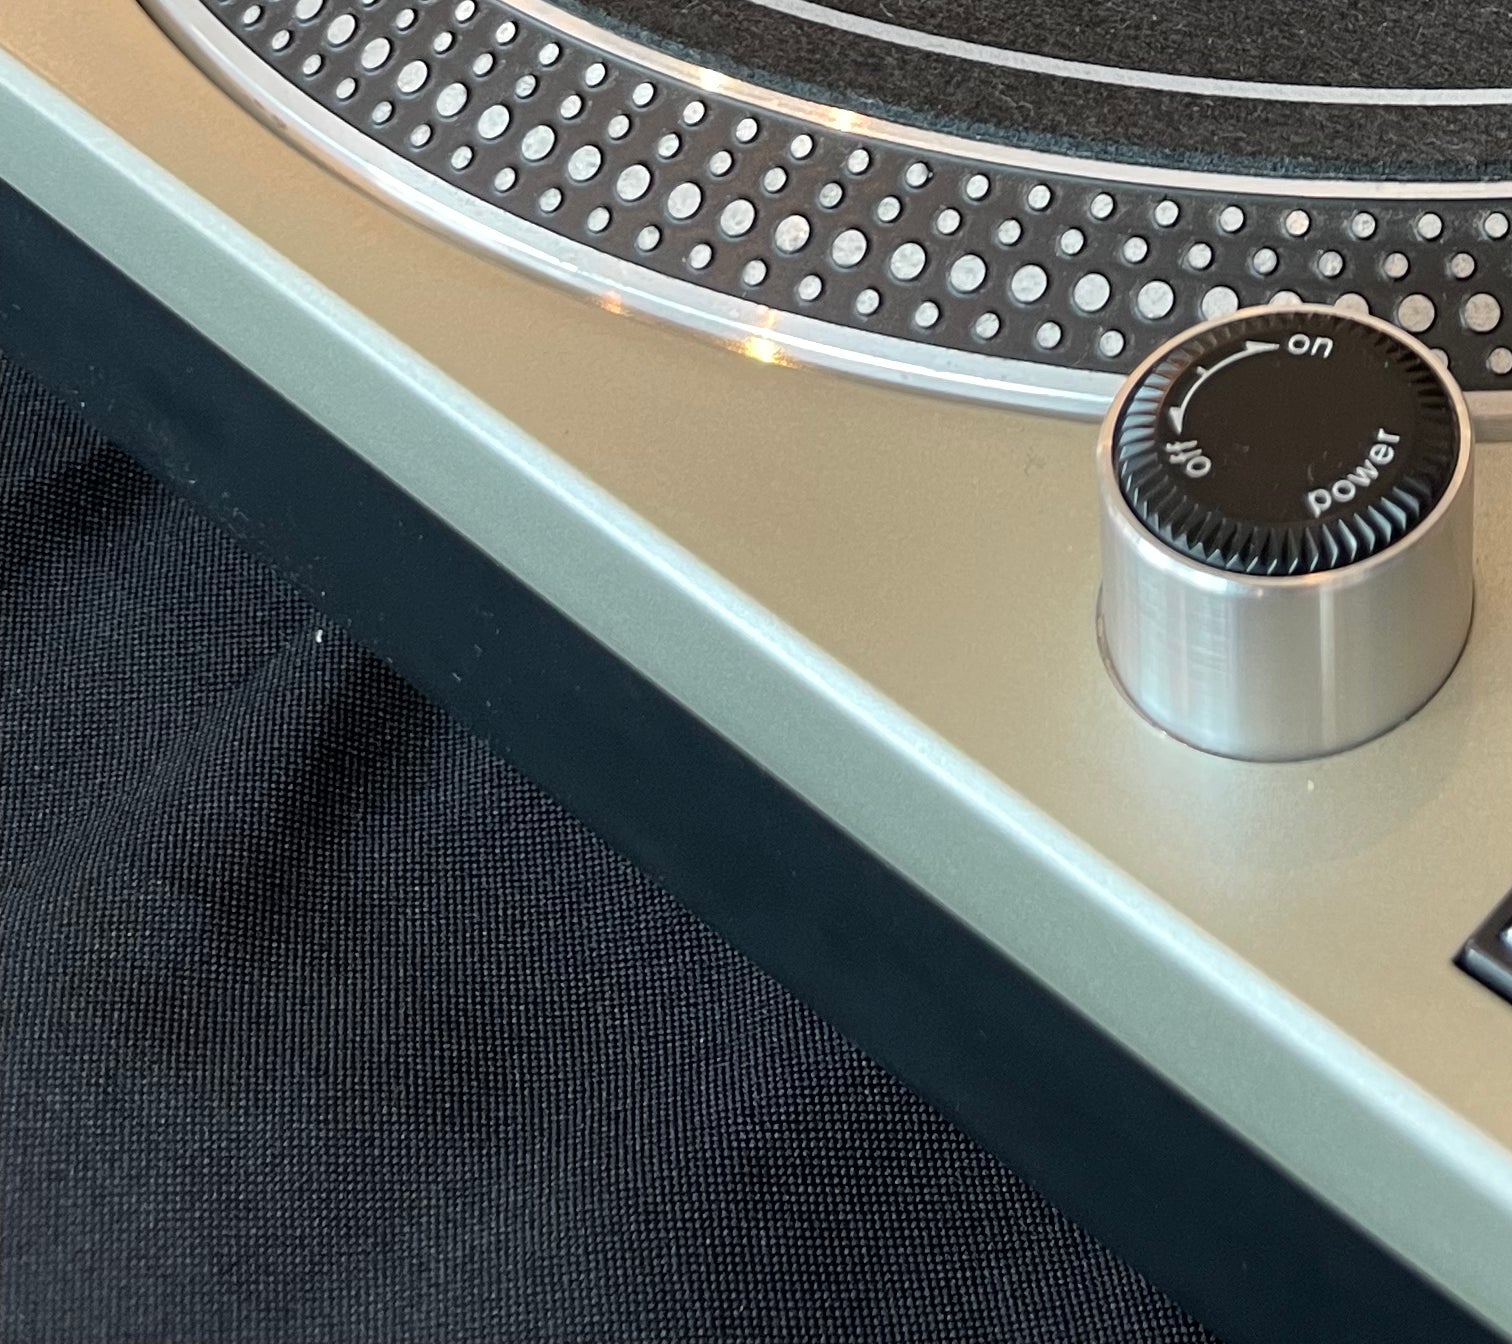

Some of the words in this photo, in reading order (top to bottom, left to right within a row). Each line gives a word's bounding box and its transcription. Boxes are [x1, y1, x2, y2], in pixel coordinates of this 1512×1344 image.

[1287, 332, 1334, 359] on
[1165, 438, 1213, 479] off
[1307, 427, 1401, 519] power
